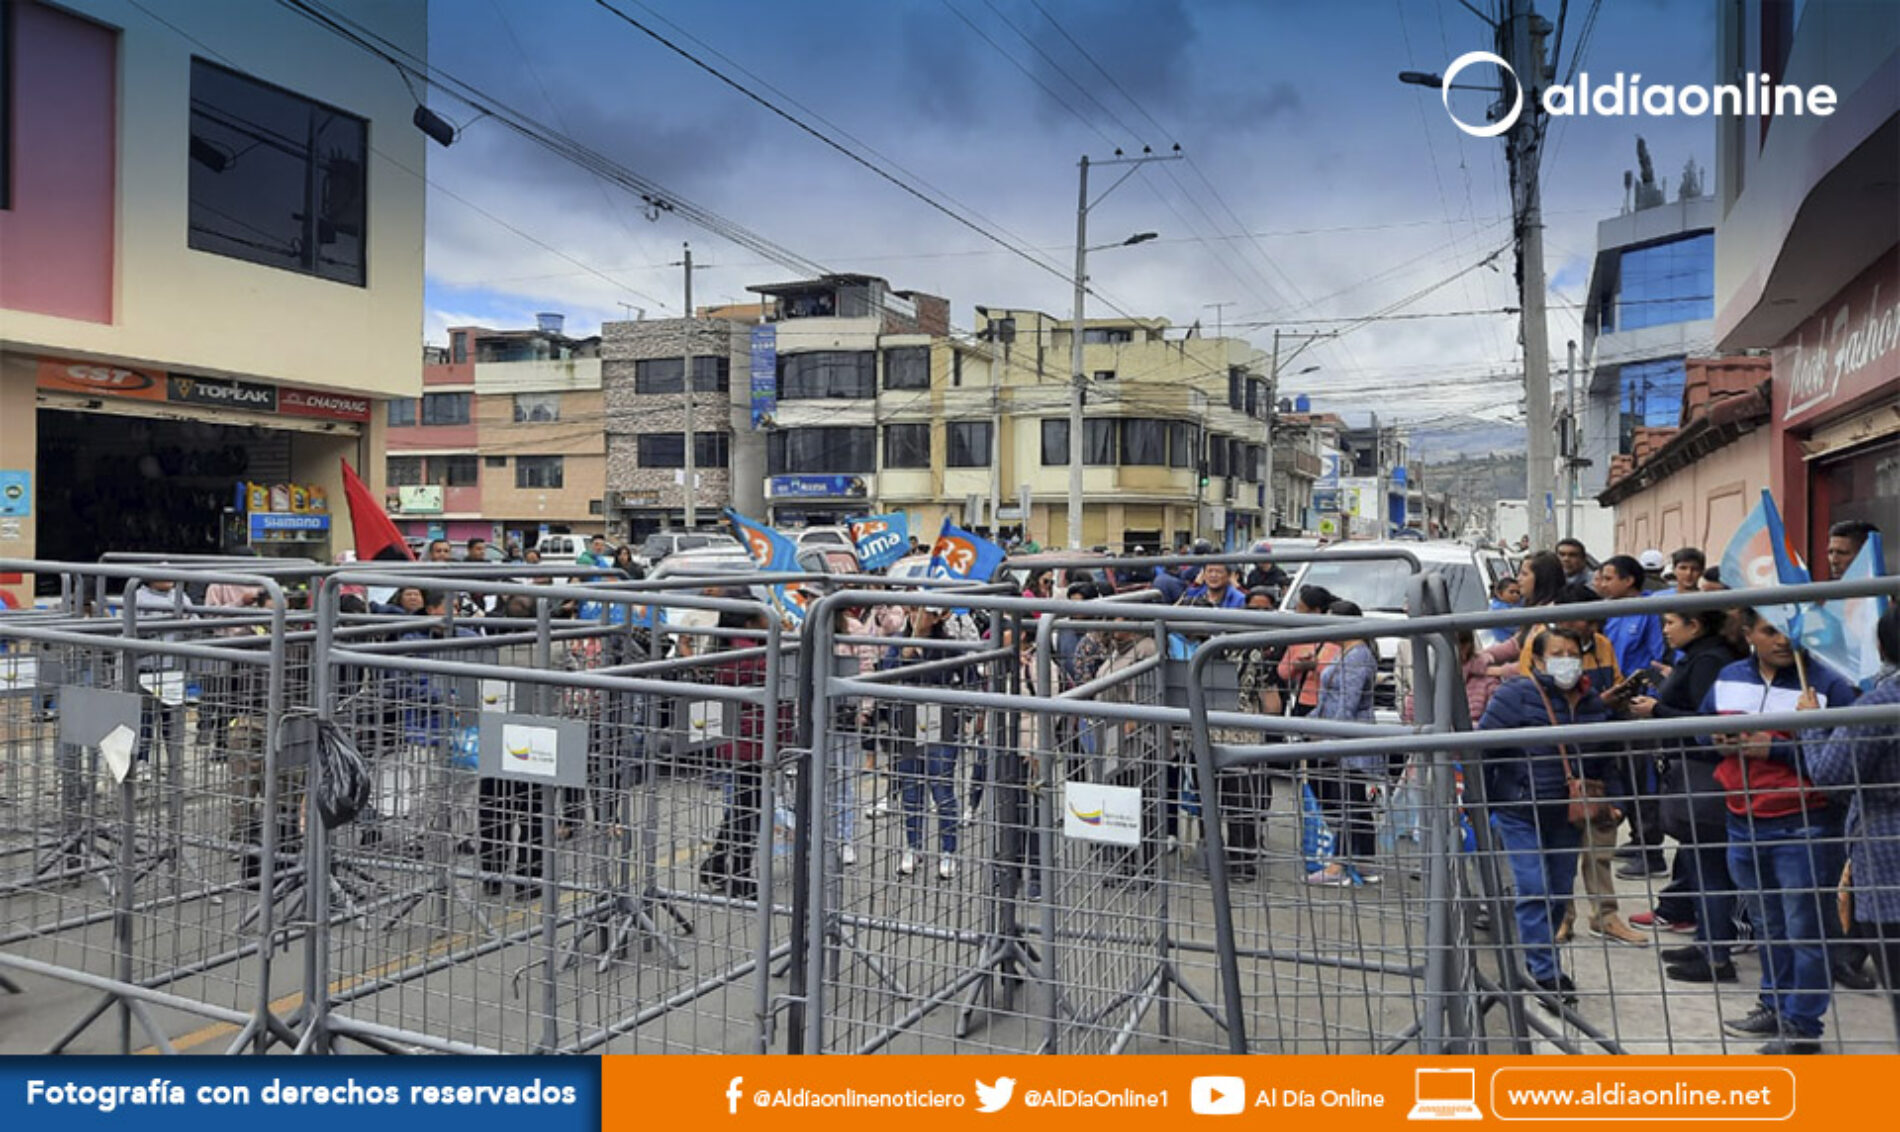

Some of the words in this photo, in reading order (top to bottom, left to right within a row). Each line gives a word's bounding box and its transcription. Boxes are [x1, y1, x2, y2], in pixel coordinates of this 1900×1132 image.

[67, 364, 133, 384] CST
[195, 380, 270, 403] TOPEAK
[264, 517, 321, 528] SHIMANO
